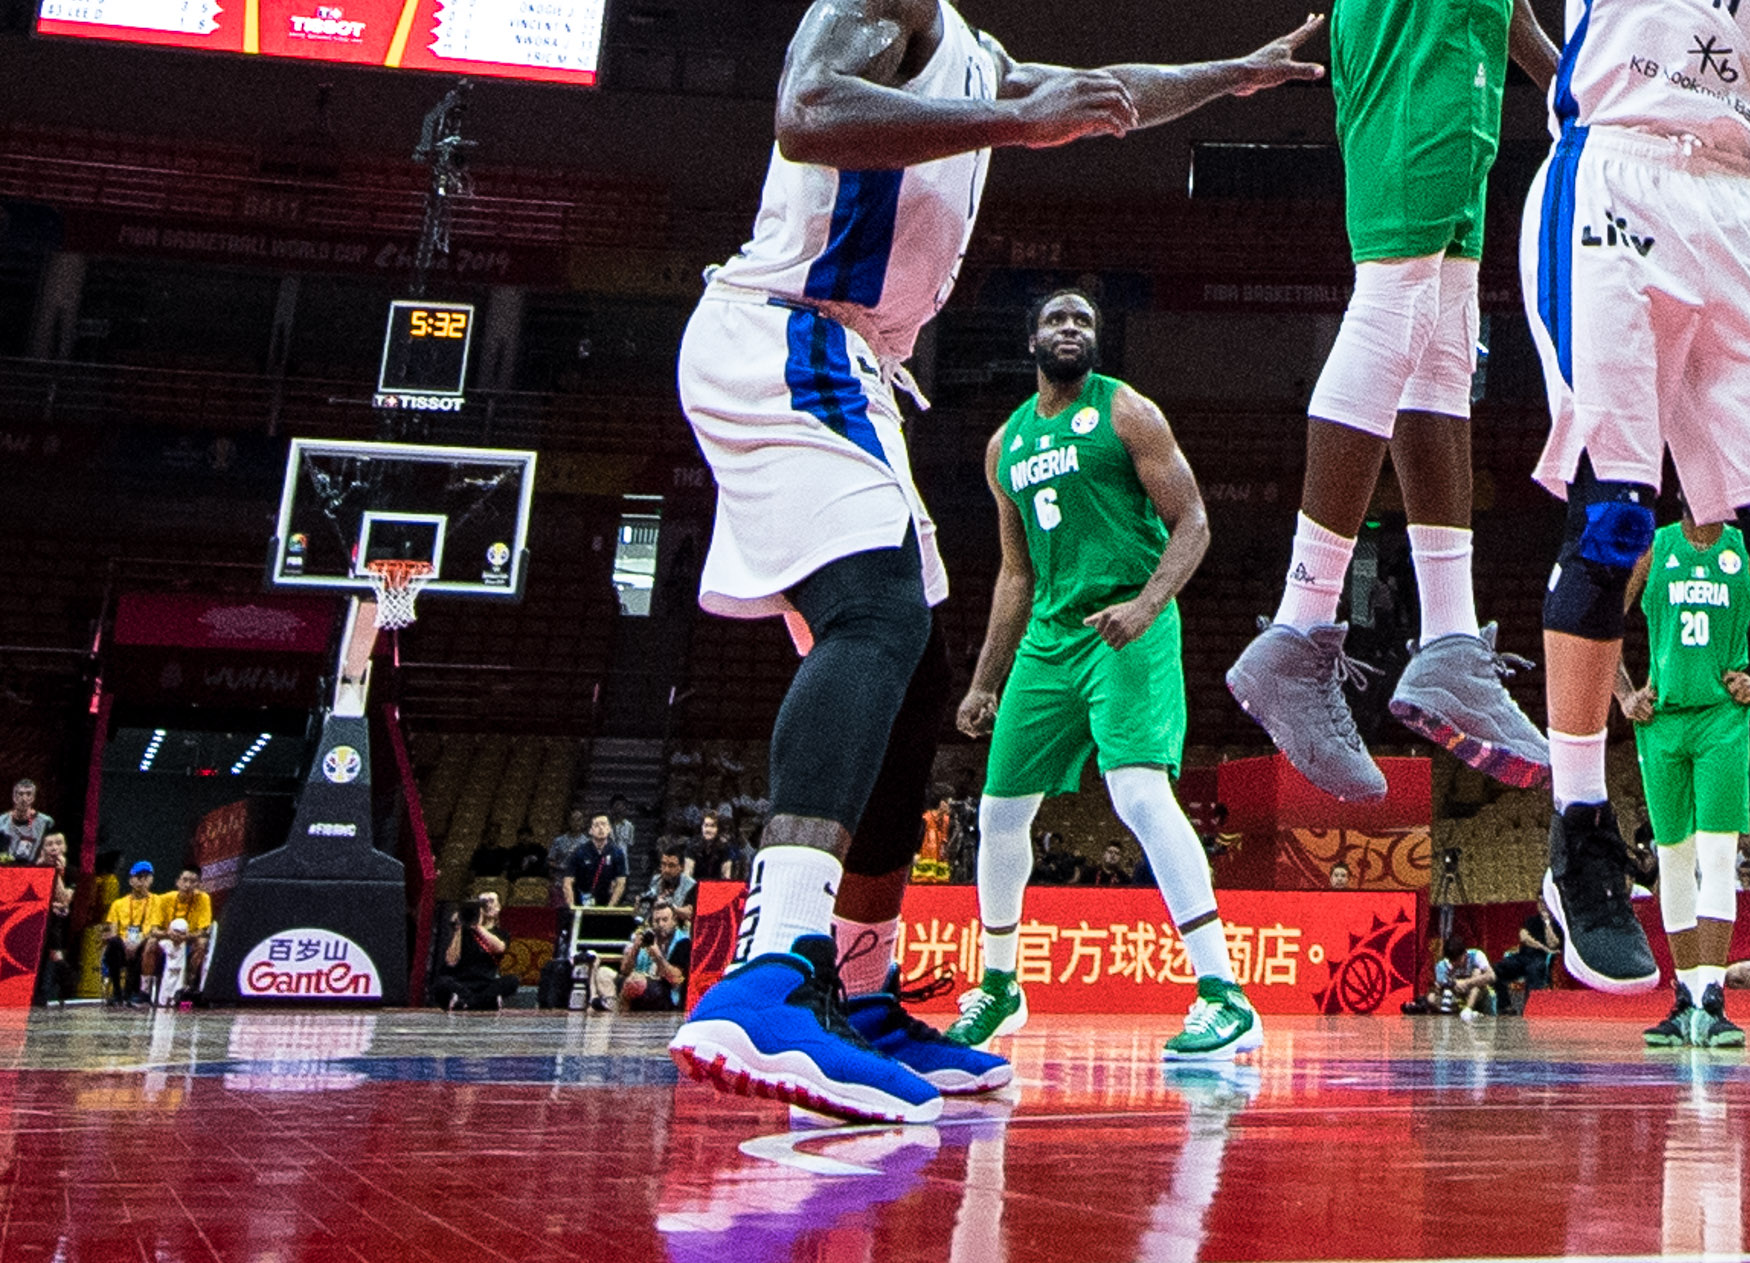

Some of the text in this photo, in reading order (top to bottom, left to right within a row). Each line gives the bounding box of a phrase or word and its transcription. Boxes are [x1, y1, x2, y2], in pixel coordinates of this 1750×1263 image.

[290, 16, 366, 37] TISSOT
[1629, 54, 1660, 79] KB
[161, 228, 268, 256] BASKETBALL
[270, 235, 329, 260] WORLD
[409, 310, 468, 339] 5:32
[399, 395, 466, 412] TISSOT
[1010, 444, 1080, 493] NIGERIA
[1034, 487, 1062, 532] 6
[1668, 580, 1730, 609] NIGERIA
[1680, 611, 1710, 646] 20
[269, 939, 348, 962] 百岁山
